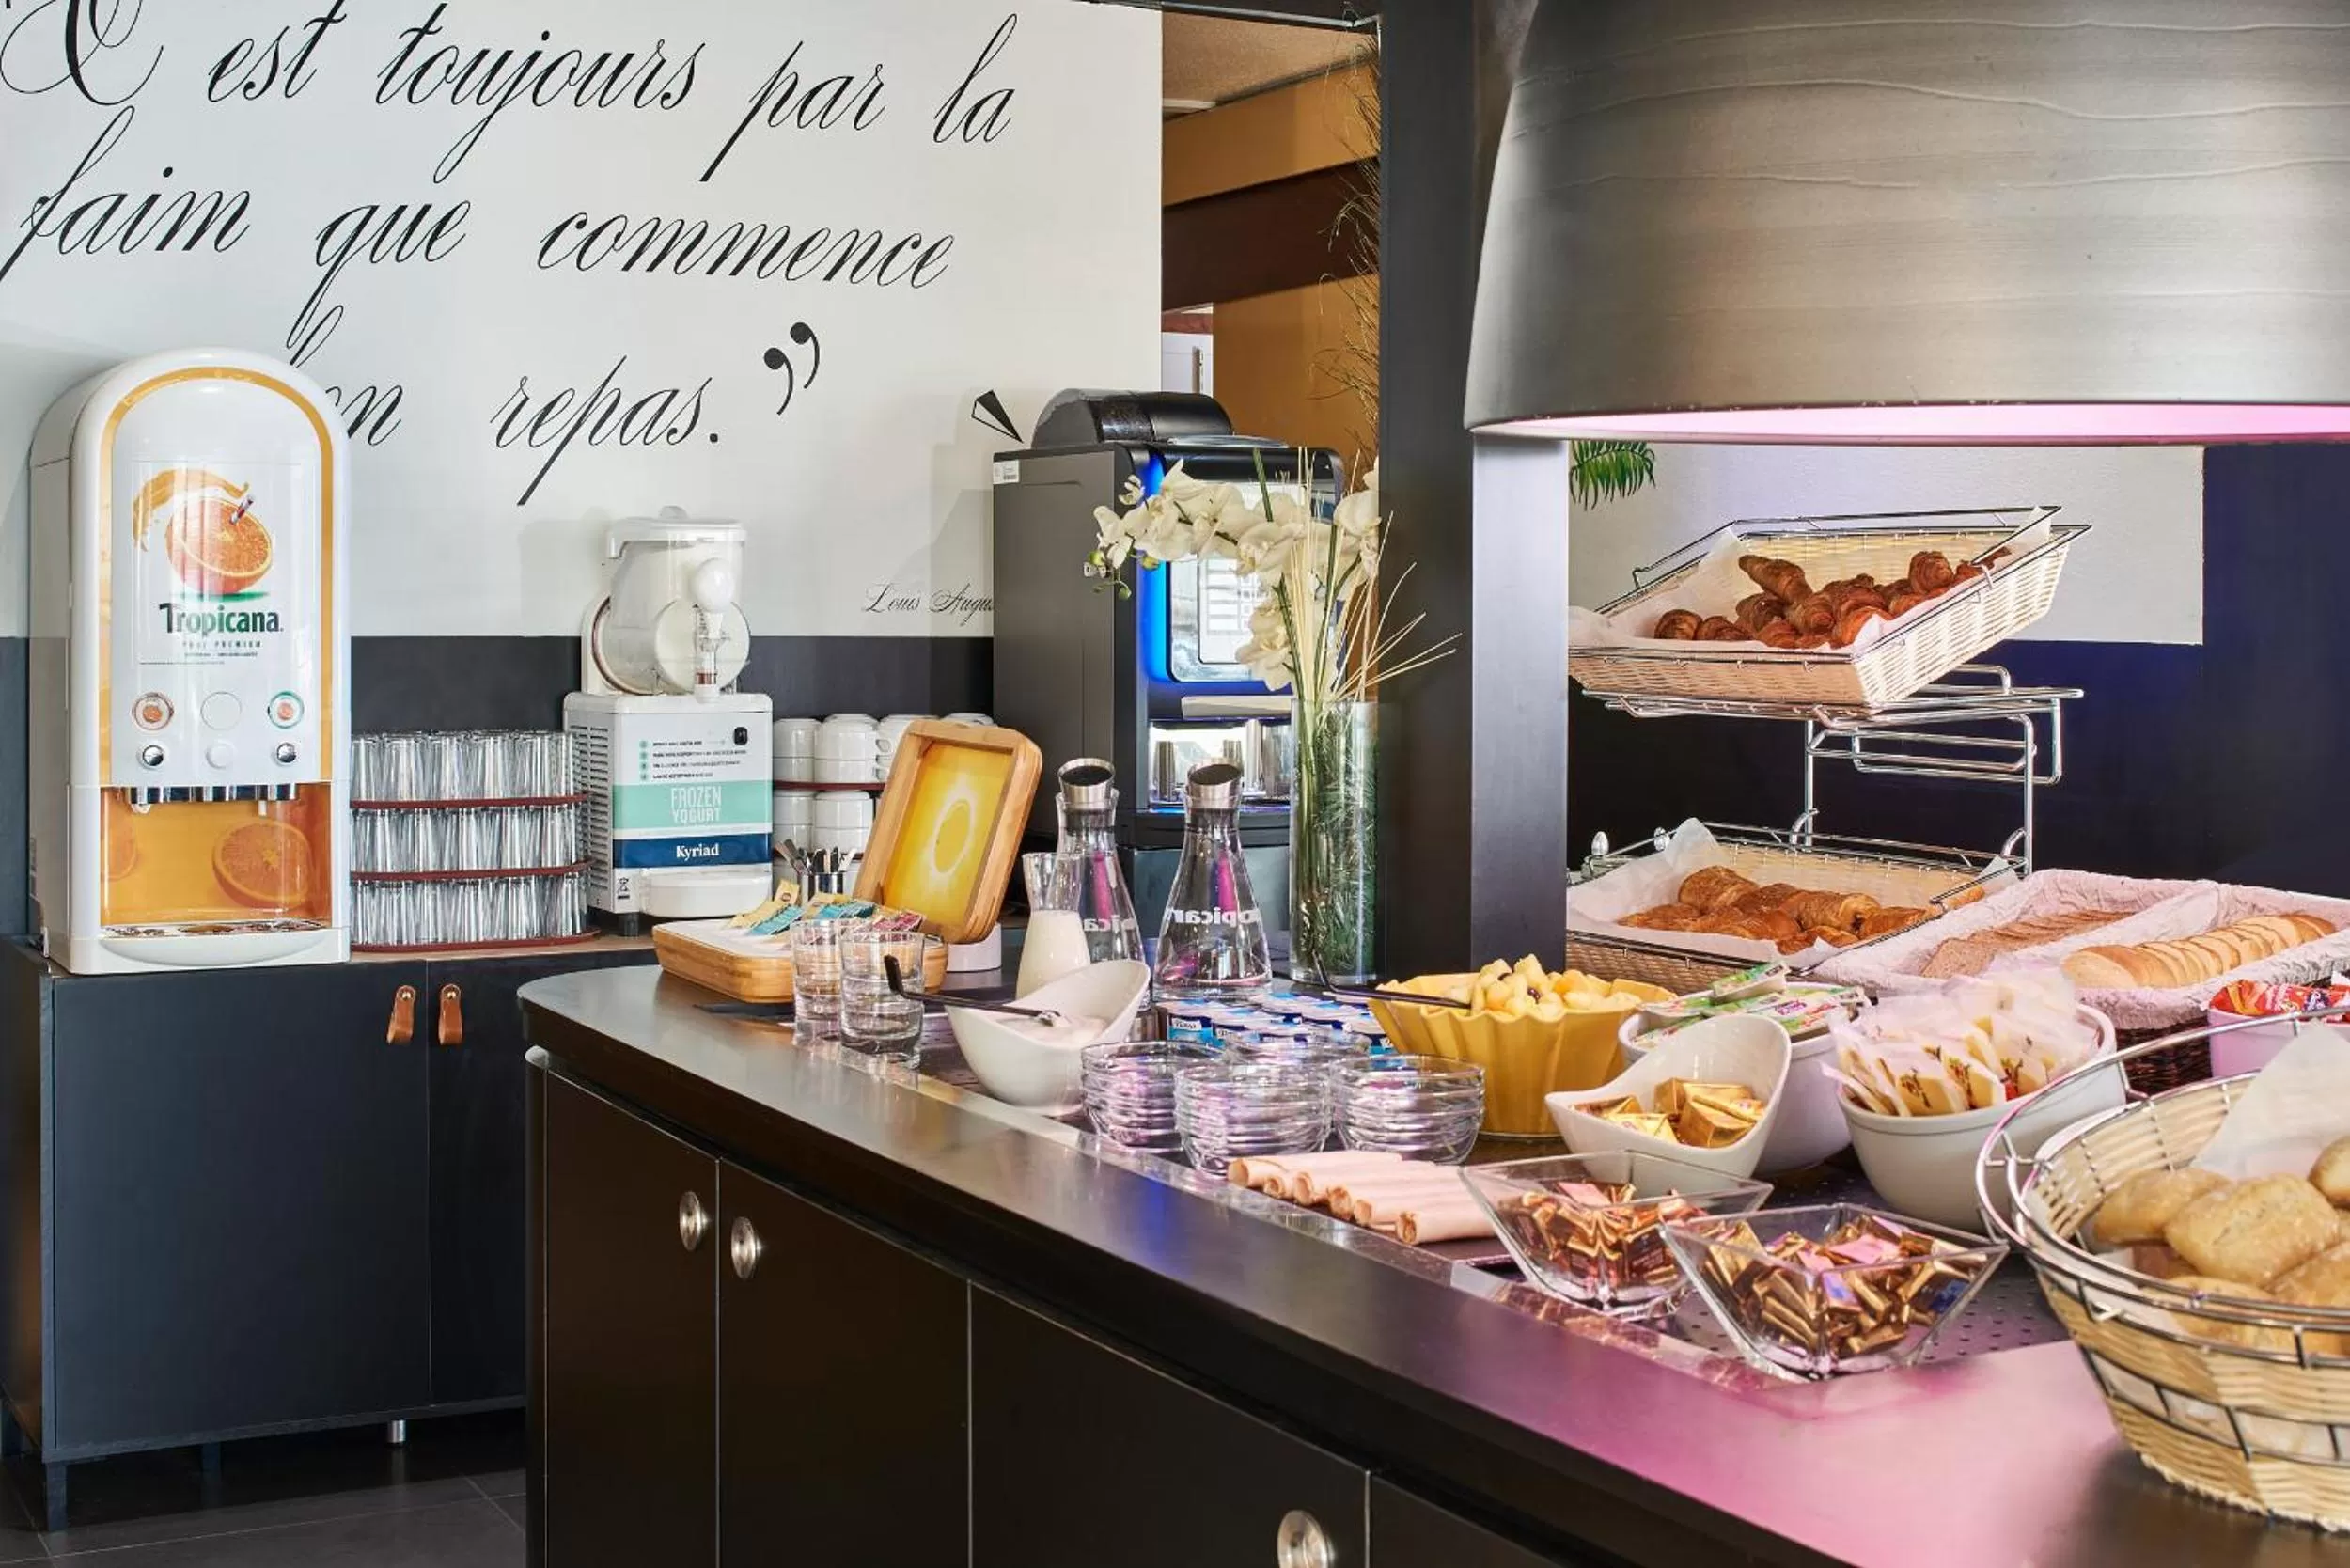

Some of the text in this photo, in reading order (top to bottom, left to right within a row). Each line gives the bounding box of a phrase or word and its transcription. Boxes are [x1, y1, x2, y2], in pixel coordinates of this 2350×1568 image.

[208, 0, 348, 102] est
[375, 3, 705, 183] toujours
[699, 40, 885, 181] par
[932, 13, 1019, 144] la
[0, 105, 955, 349] faim que commence
[159, 602, 284, 637] Tropicana
[670, 786, 722, 808] FROZEN
[672, 808, 722, 824] YOGURT
[676, 843, 720, 862] Kyriad
